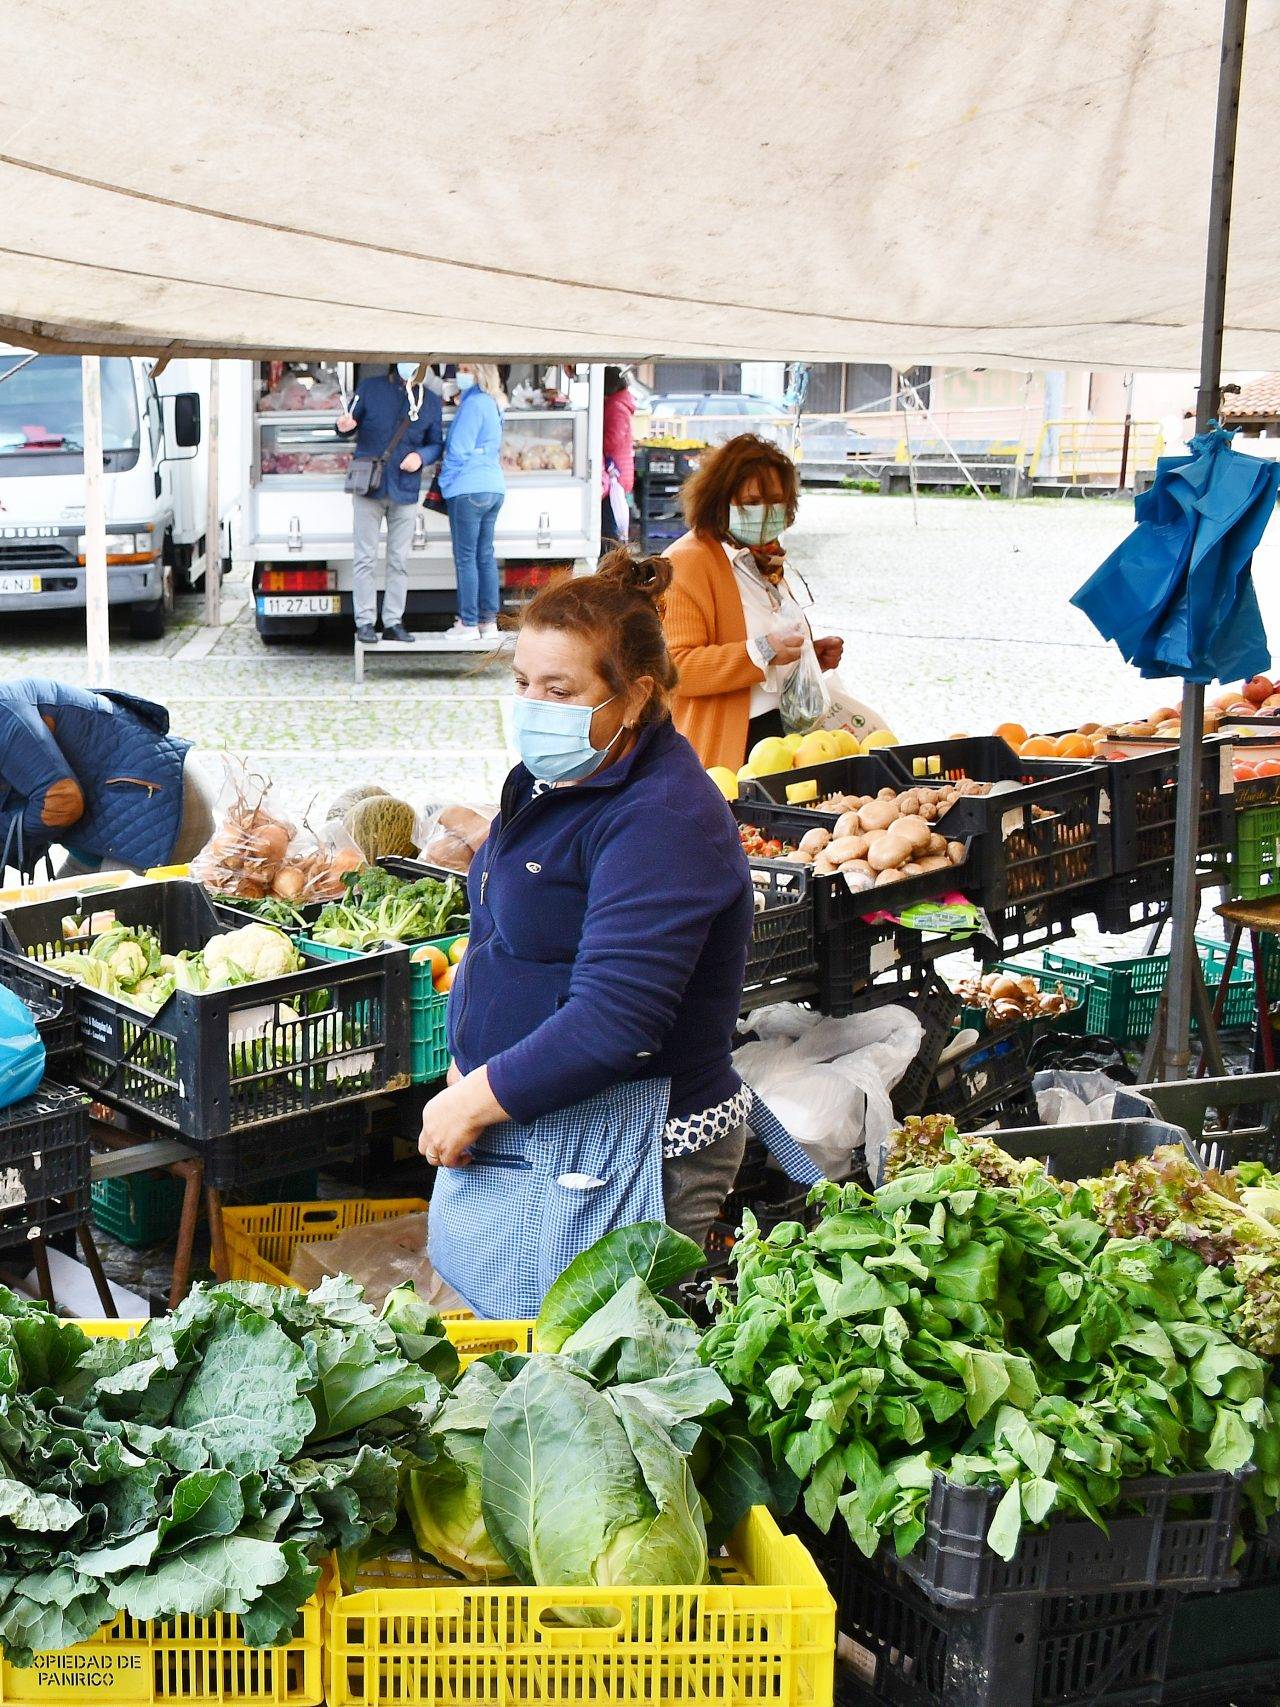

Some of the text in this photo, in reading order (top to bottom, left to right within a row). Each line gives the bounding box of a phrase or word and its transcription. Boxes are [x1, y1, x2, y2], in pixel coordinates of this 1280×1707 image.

[11, 1655, 142, 1669] OPIEDAD DE
[38, 1672, 115, 1687] PANRICO
